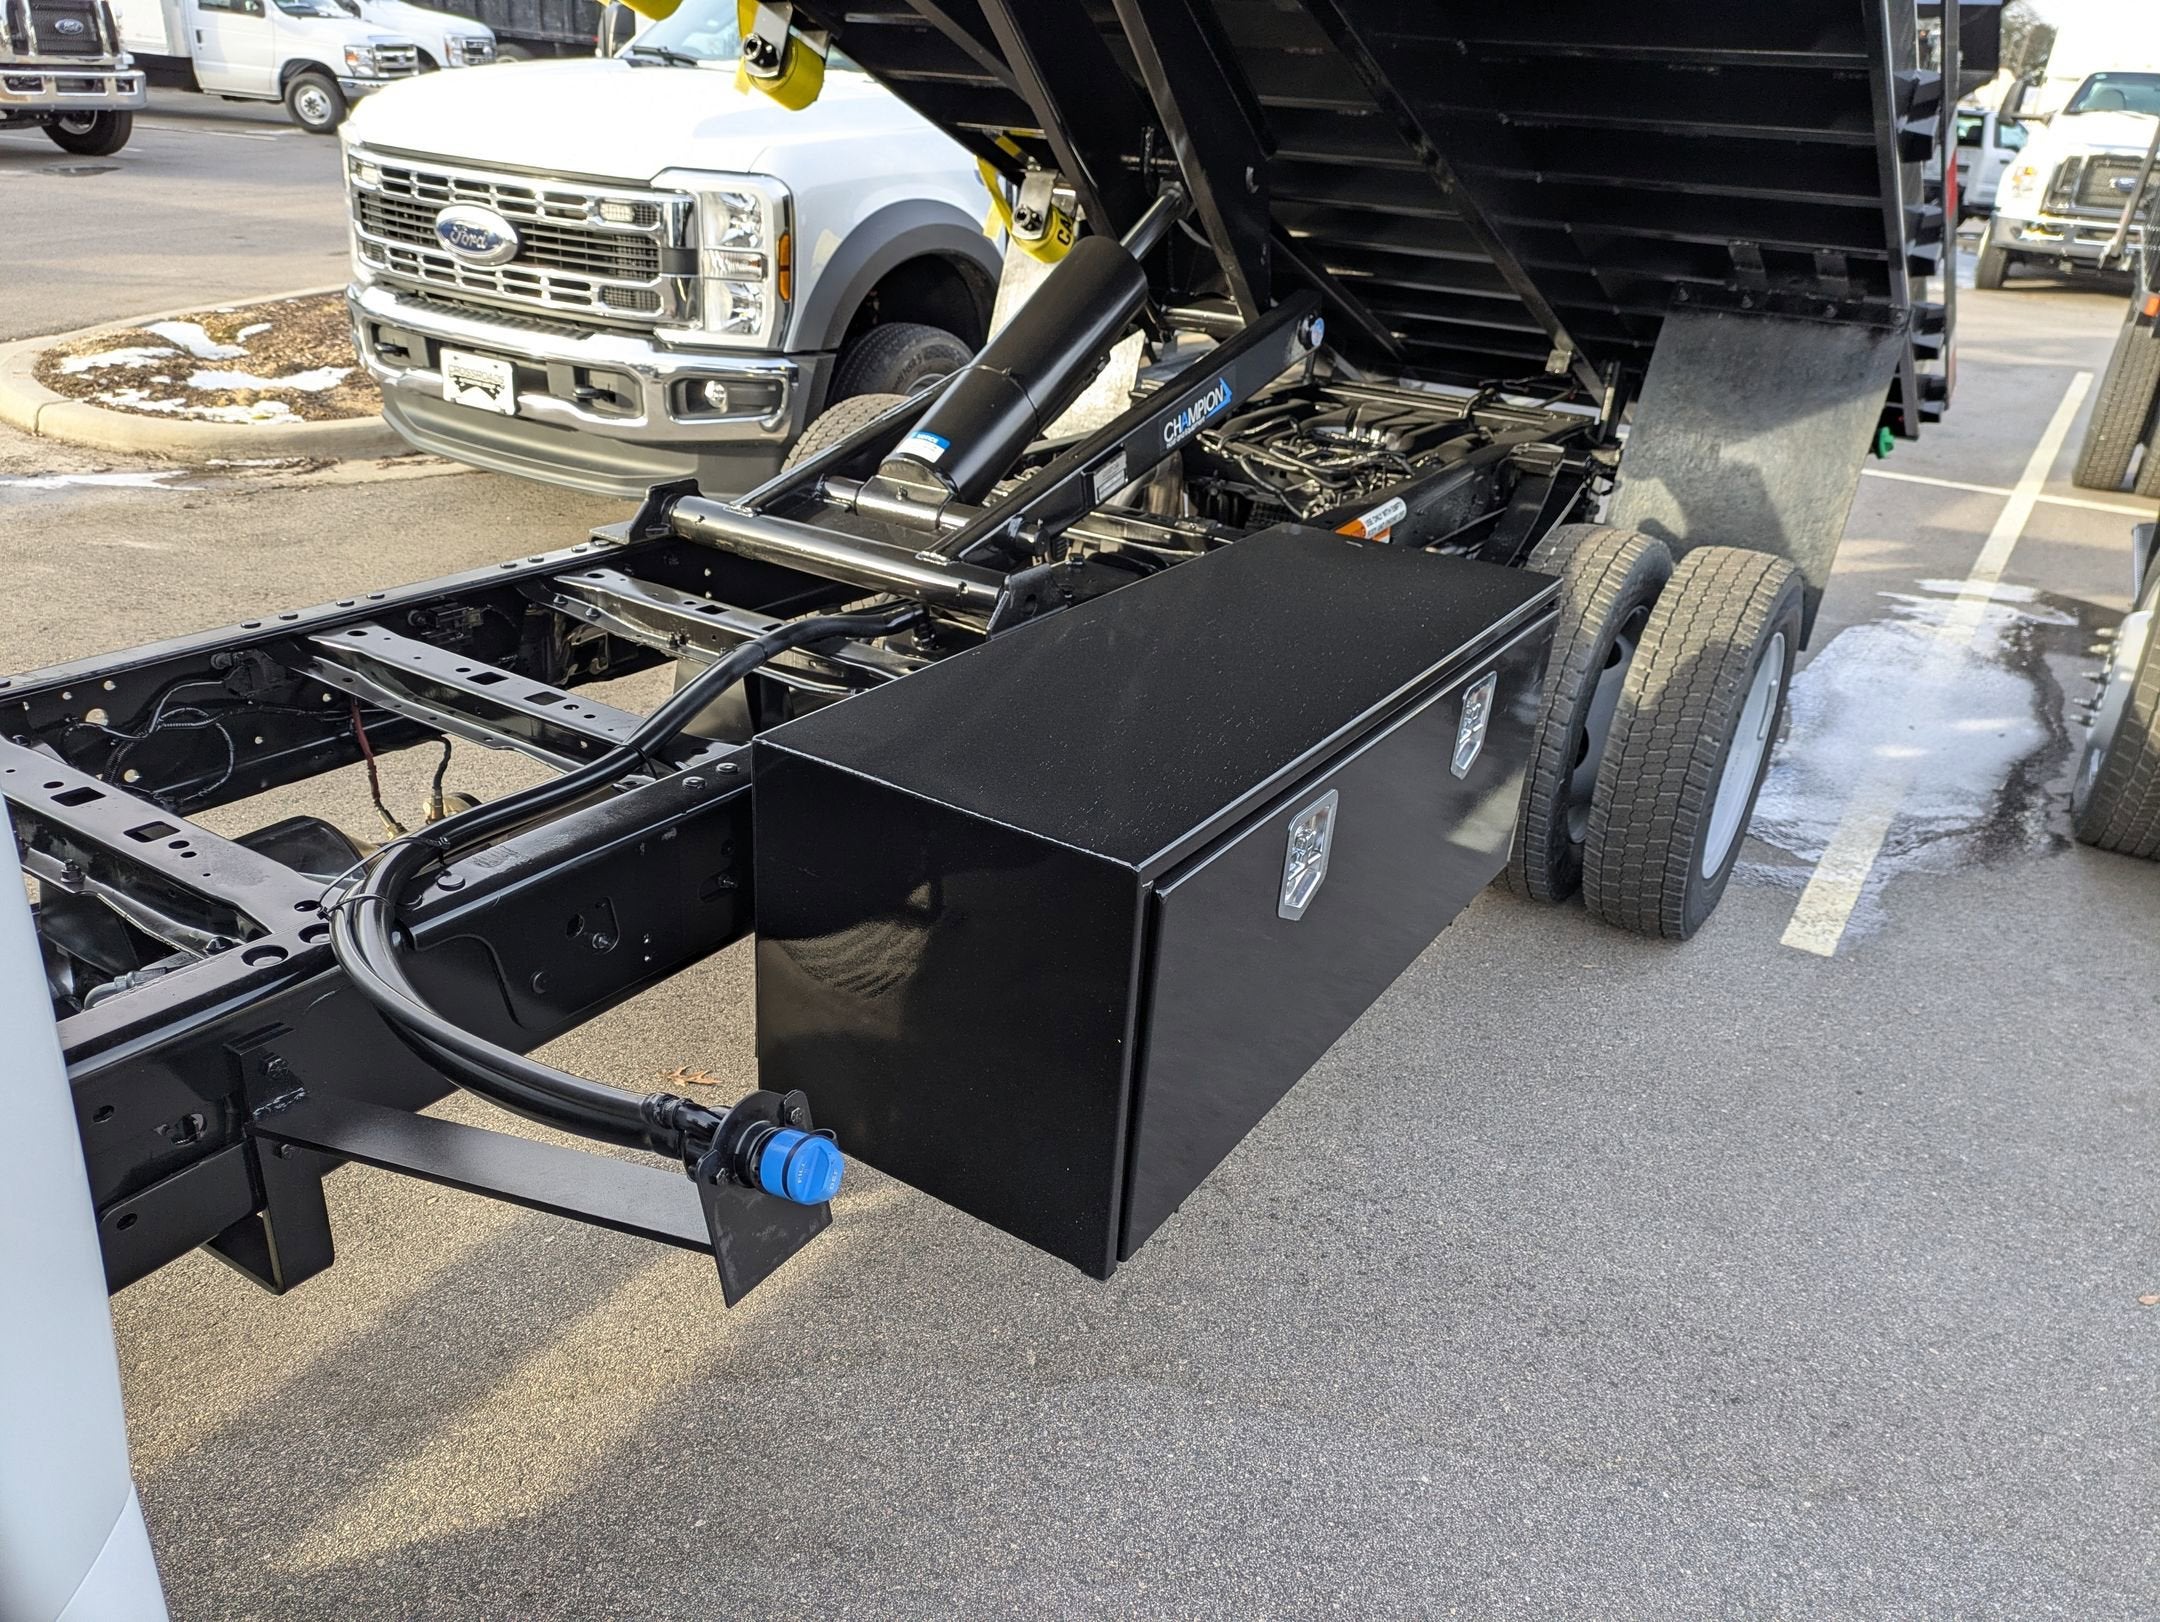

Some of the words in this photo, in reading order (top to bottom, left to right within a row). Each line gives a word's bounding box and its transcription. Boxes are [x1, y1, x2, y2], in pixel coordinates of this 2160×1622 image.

[449, 224, 489, 249] Ford
[448, 364, 504, 385] CROSSROADS
[1164, 385, 1223, 442] CHAMPION
